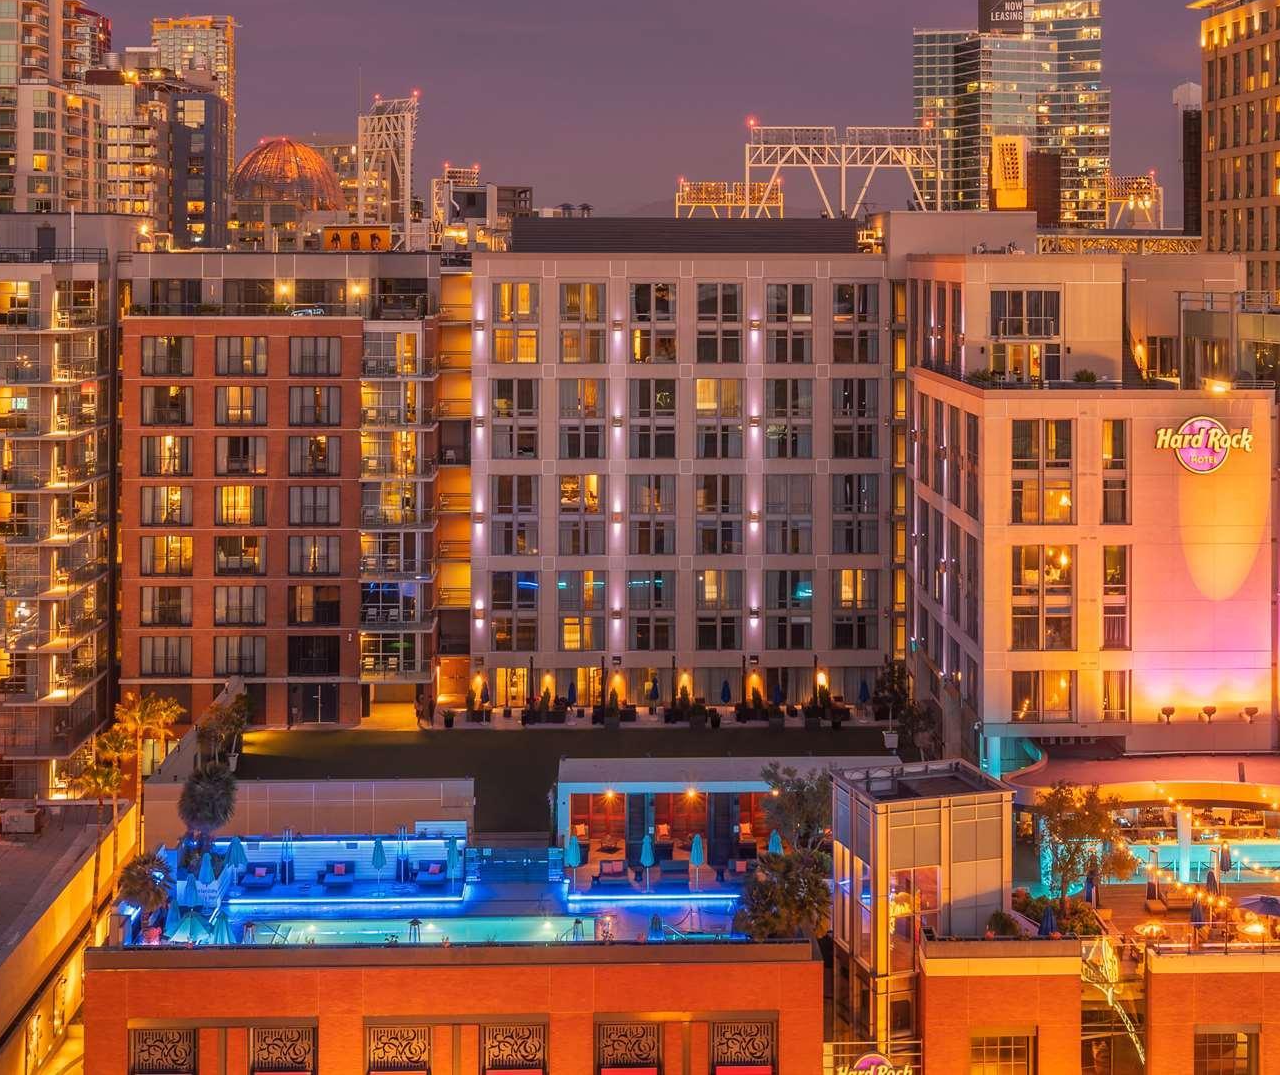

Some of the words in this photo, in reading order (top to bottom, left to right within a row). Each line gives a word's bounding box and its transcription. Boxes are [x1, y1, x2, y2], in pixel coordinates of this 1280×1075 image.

[1005, 1, 1023, 11] NOW
[991, 12, 1023, 21] LEASING
[1155, 428, 1207, 449] Hard
[1207, 427, 1254, 453] Rock
[1191, 455, 1218, 464] HOTEL
